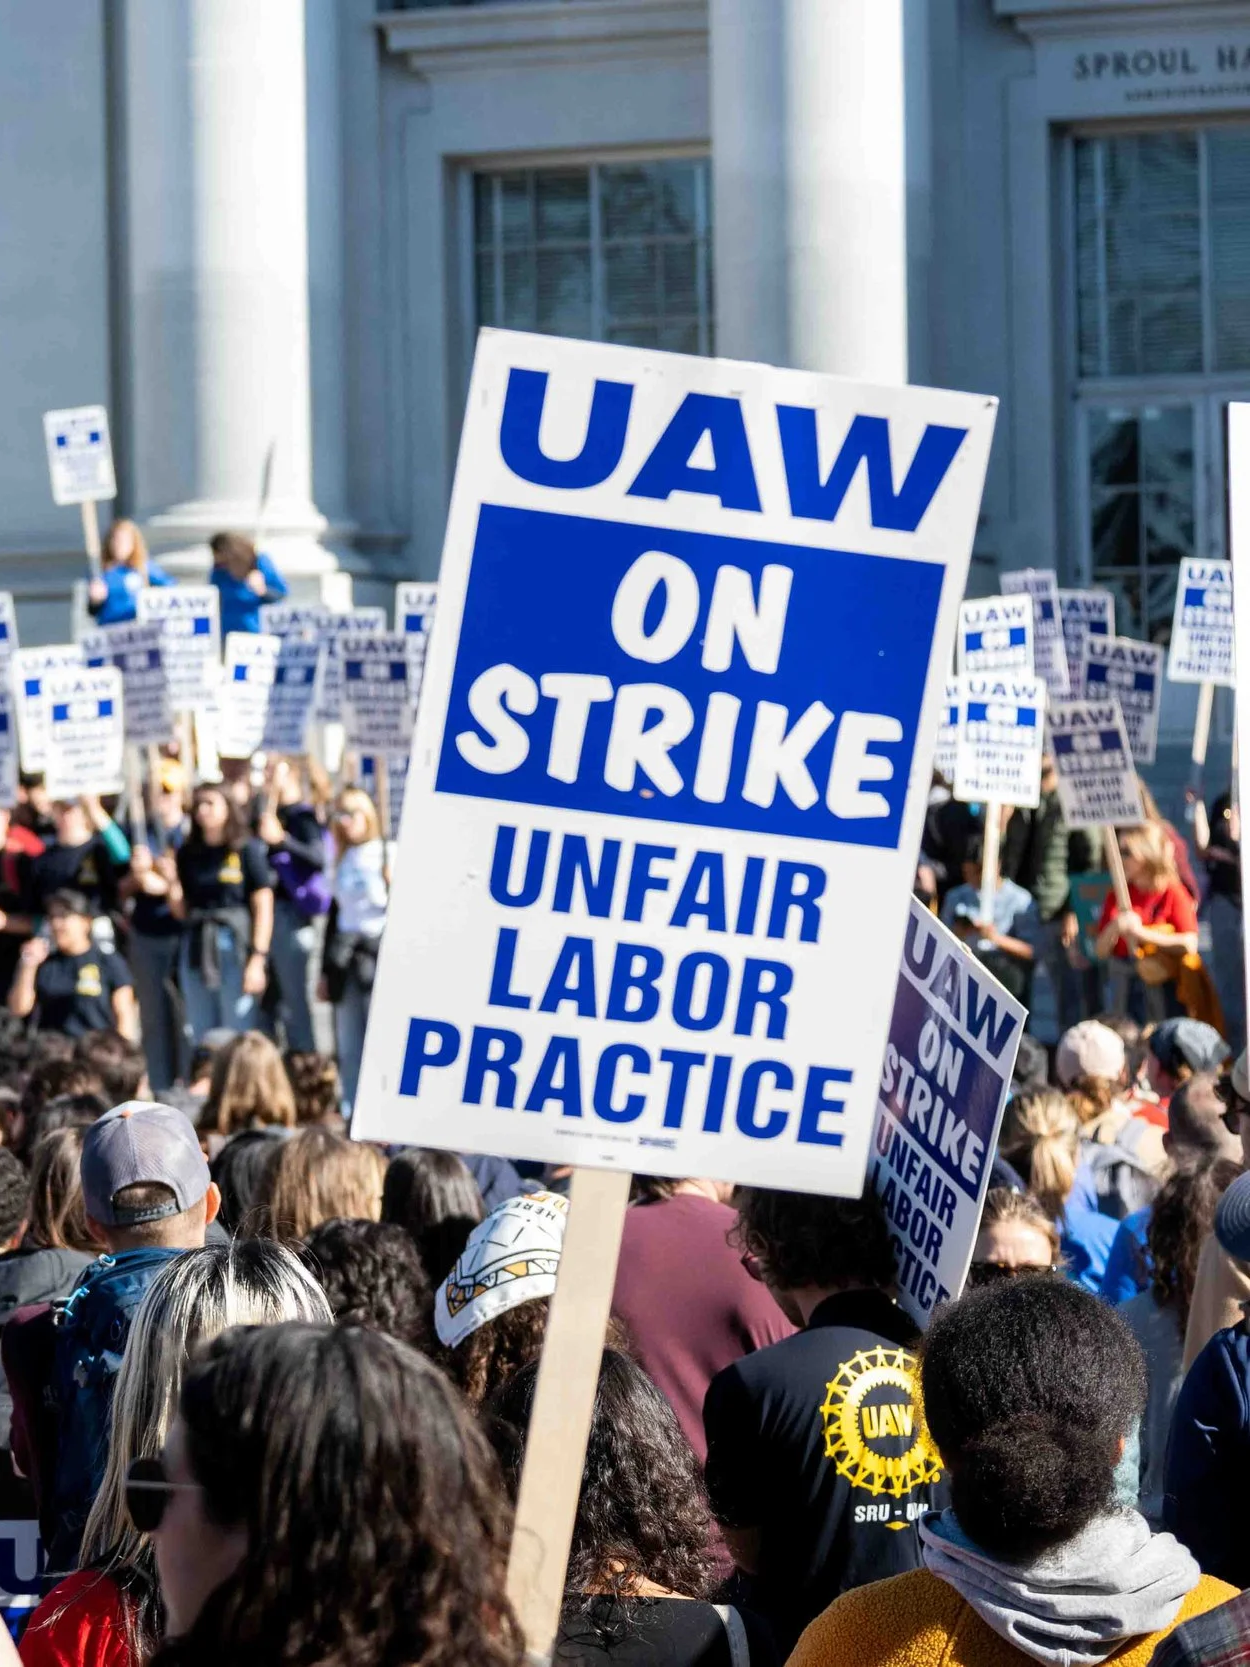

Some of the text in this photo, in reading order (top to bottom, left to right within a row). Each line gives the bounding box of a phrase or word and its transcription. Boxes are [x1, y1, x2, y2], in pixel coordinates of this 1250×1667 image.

[1074, 48, 1197, 81] SPROUL
[498, 367, 970, 533] UAW
[611, 550, 794, 674] ON
[964, 606, 1025, 624] UAW
[1187, 567, 1232, 583] UA
[969, 680, 1037, 699] UAW
[1089, 643, 1157, 667] UAW
[456, 663, 903, 819] STRIKE
[1048, 709, 1113, 729] UAW
[489, 825, 828, 944] UNFAIR
[488, 927, 794, 1040] LABOR
[904, 912, 1018, 1060] UAW
[398, 1017, 854, 1147] PRACTICE
[918, 1019, 964, 1098] ON
[880, 1043, 984, 1185] STRIKE
[876, 1114, 958, 1231] UNFAIR
[861, 1404, 915, 1439] UAW
[854, 1504, 890, 1523] SRU
